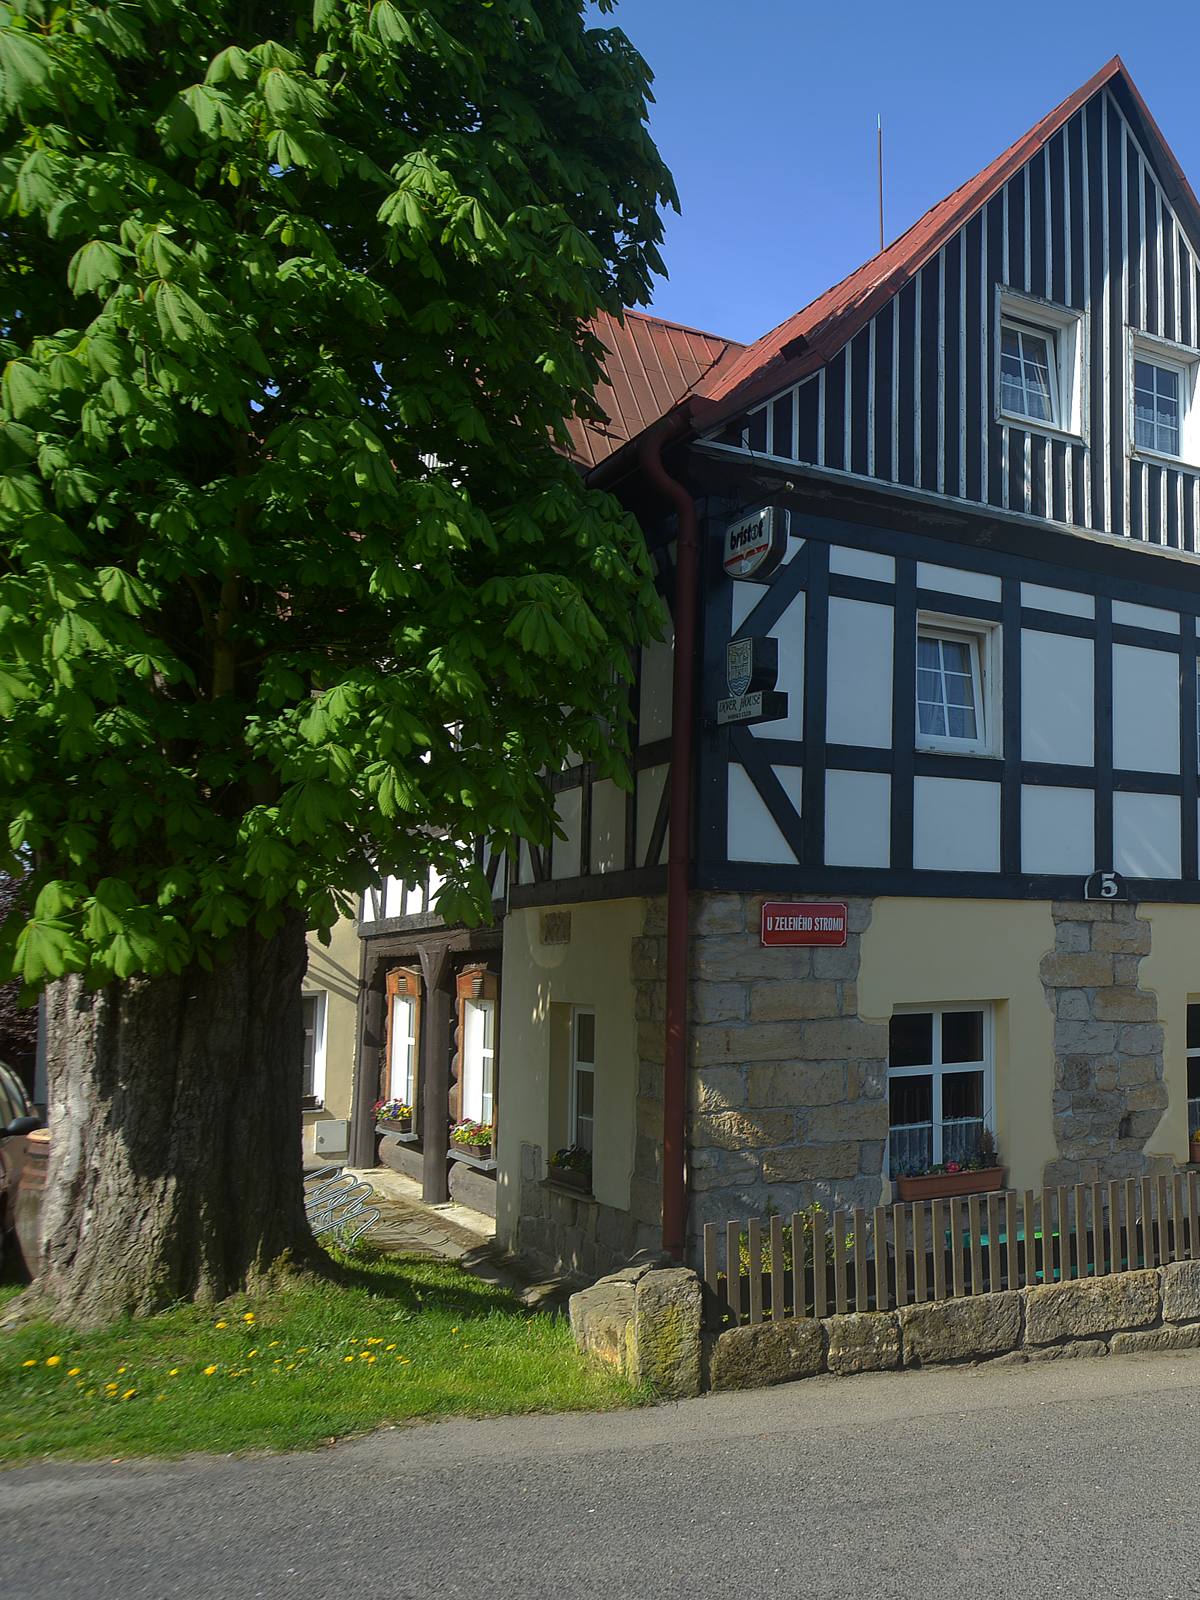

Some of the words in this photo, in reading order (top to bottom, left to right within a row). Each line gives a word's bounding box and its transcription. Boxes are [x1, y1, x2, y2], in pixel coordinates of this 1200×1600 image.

[1101, 873, 1118, 897] 5
[767, 916, 774, 931] U
[775, 914, 813, 931] ZELENÉHO
[814, 917, 844, 931] STROMU
